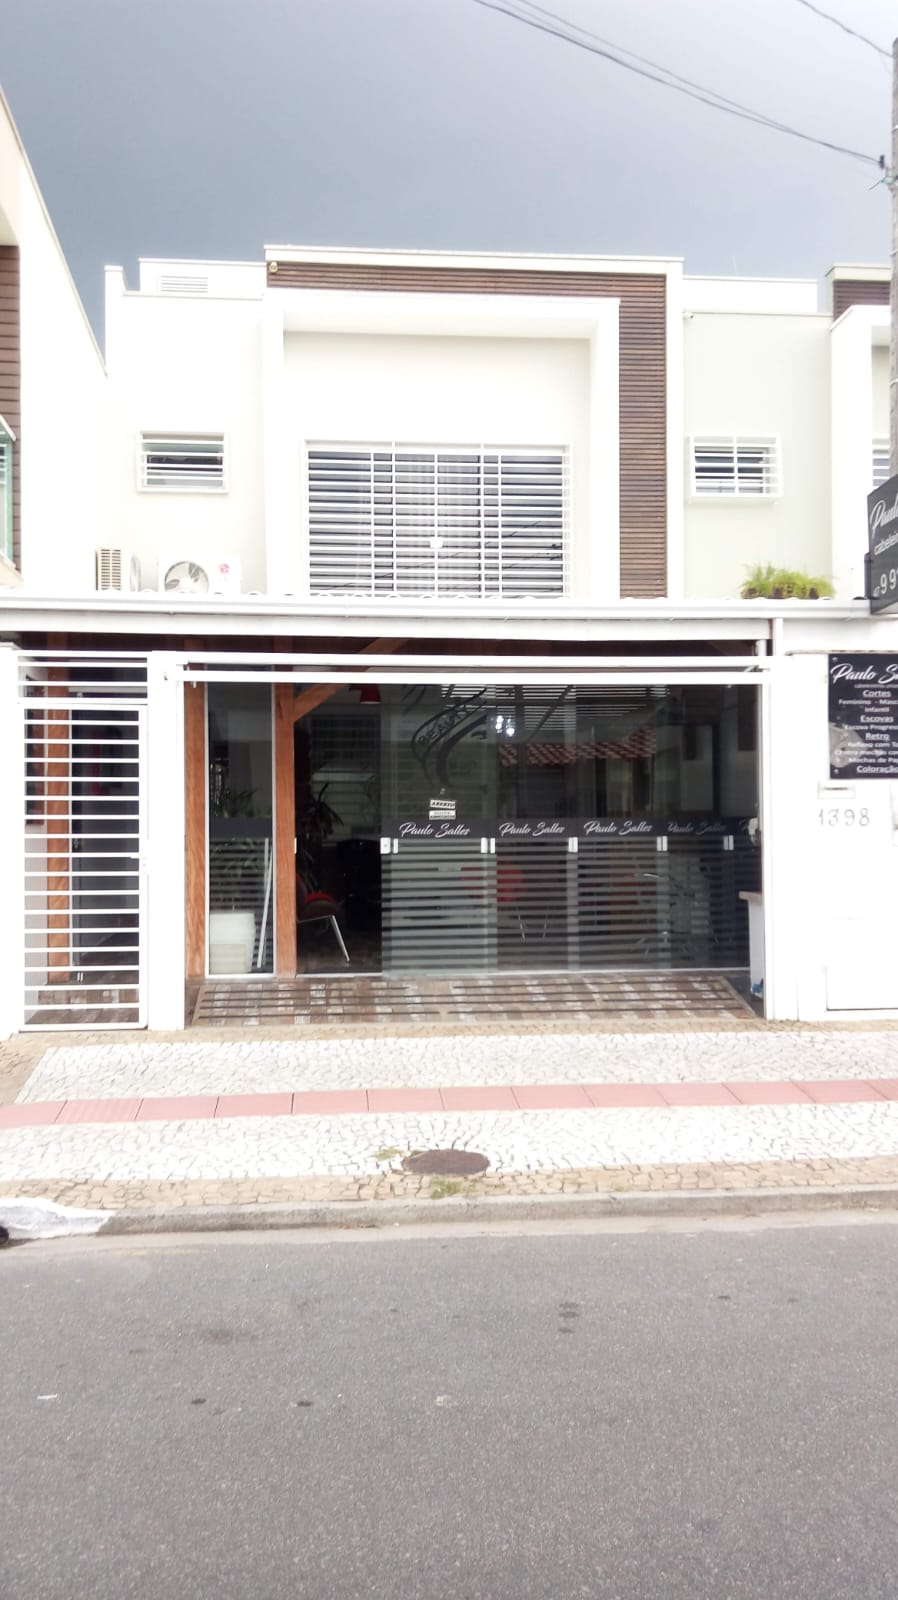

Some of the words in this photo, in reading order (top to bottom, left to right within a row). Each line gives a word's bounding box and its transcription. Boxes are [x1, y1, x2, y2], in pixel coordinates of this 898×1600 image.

[881, 568, 898, 594] 99
[830, 663, 876, 684] Paulo
[862, 690, 892, 698] Cortes
[860, 715, 894, 723] Escovas
[818, 807, 870, 827] 1398
[399, 822, 433, 837] Paulo
[435, 822, 470, 838] Salles
[499, 822, 531, 836] Paulo
[532, 821, 565, 837] Salles
[583, 820, 617, 834] Paulo
[618, 820, 652, 836] Salles
